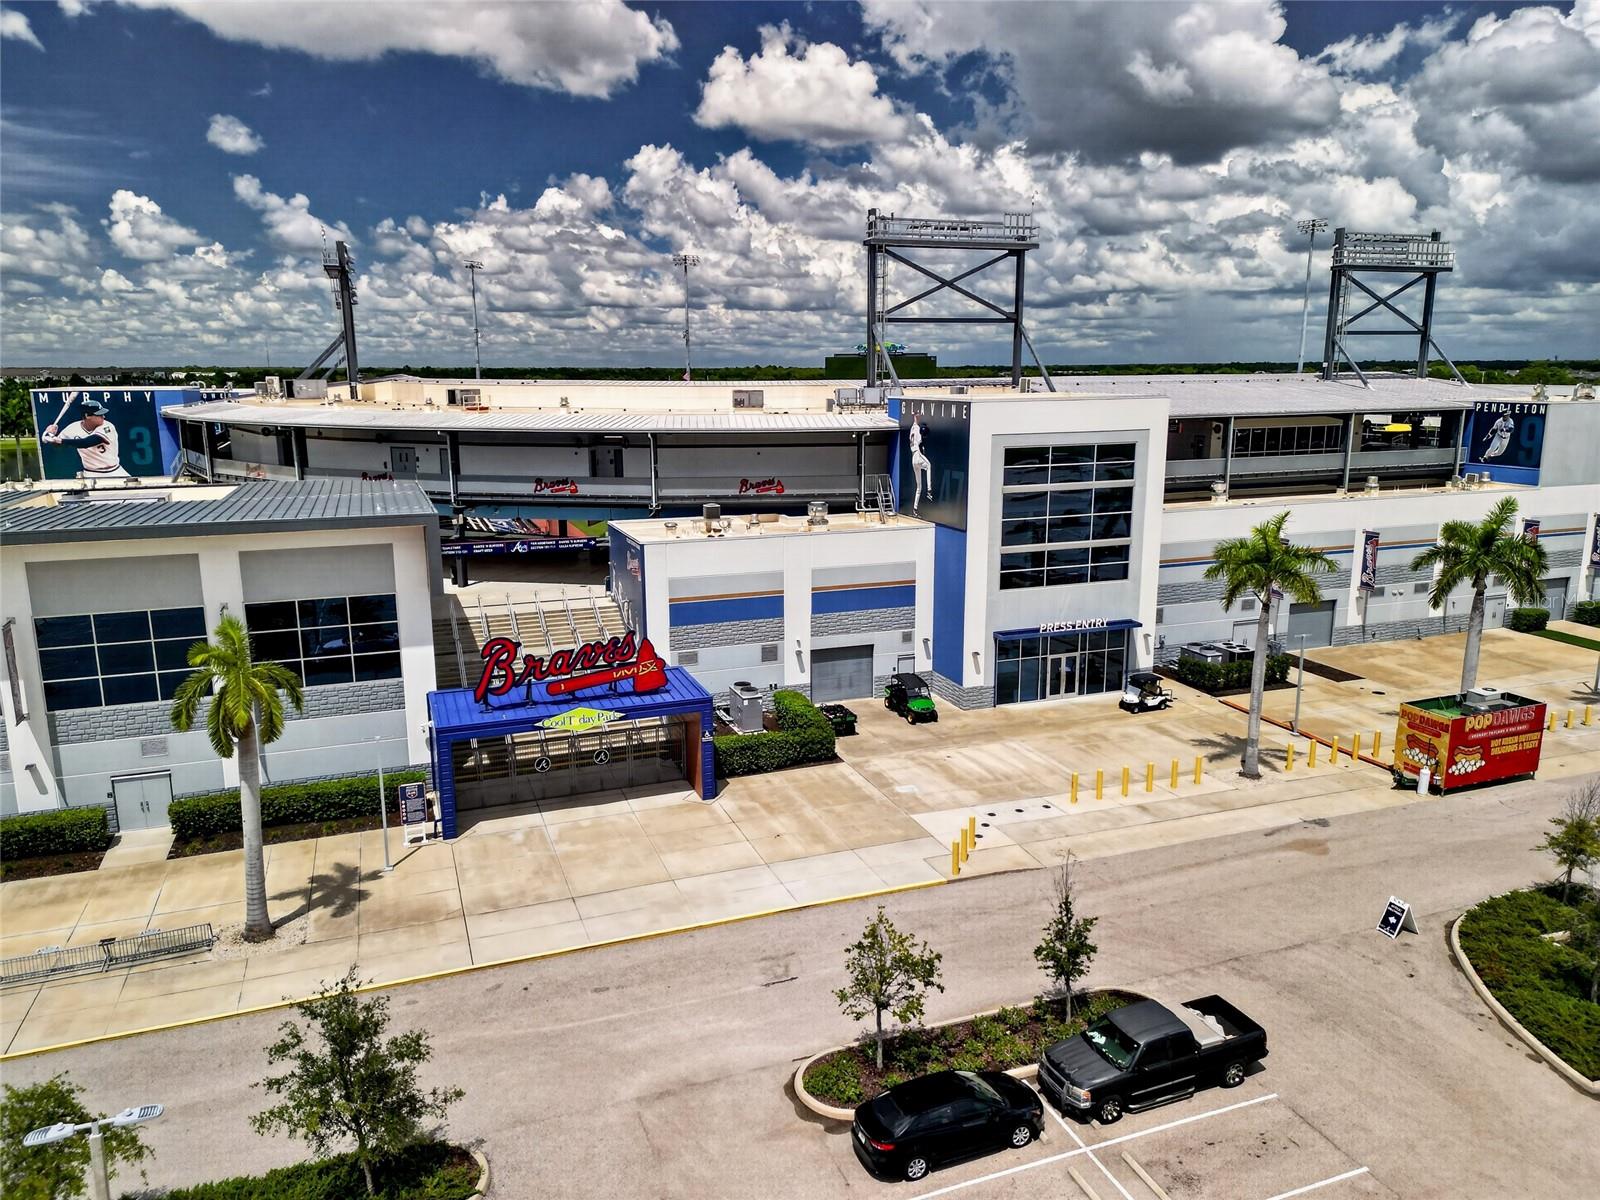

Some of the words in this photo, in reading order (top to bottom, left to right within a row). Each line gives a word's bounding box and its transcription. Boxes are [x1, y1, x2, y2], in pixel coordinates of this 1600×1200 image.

[39, 391, 151, 404] MURPHY
[901, 401, 968, 419] GLAVINE
[1475, 402, 1547, 415] PENDLETON
[129, 426, 153, 465] 3
[1517, 415, 1544, 464] 9
[97, 444, 106, 454] 3
[1040, 620, 1073, 633] PRESS
[1075, 617, 1108, 630] ENTRY
[474, 630, 635, 703] Braves
